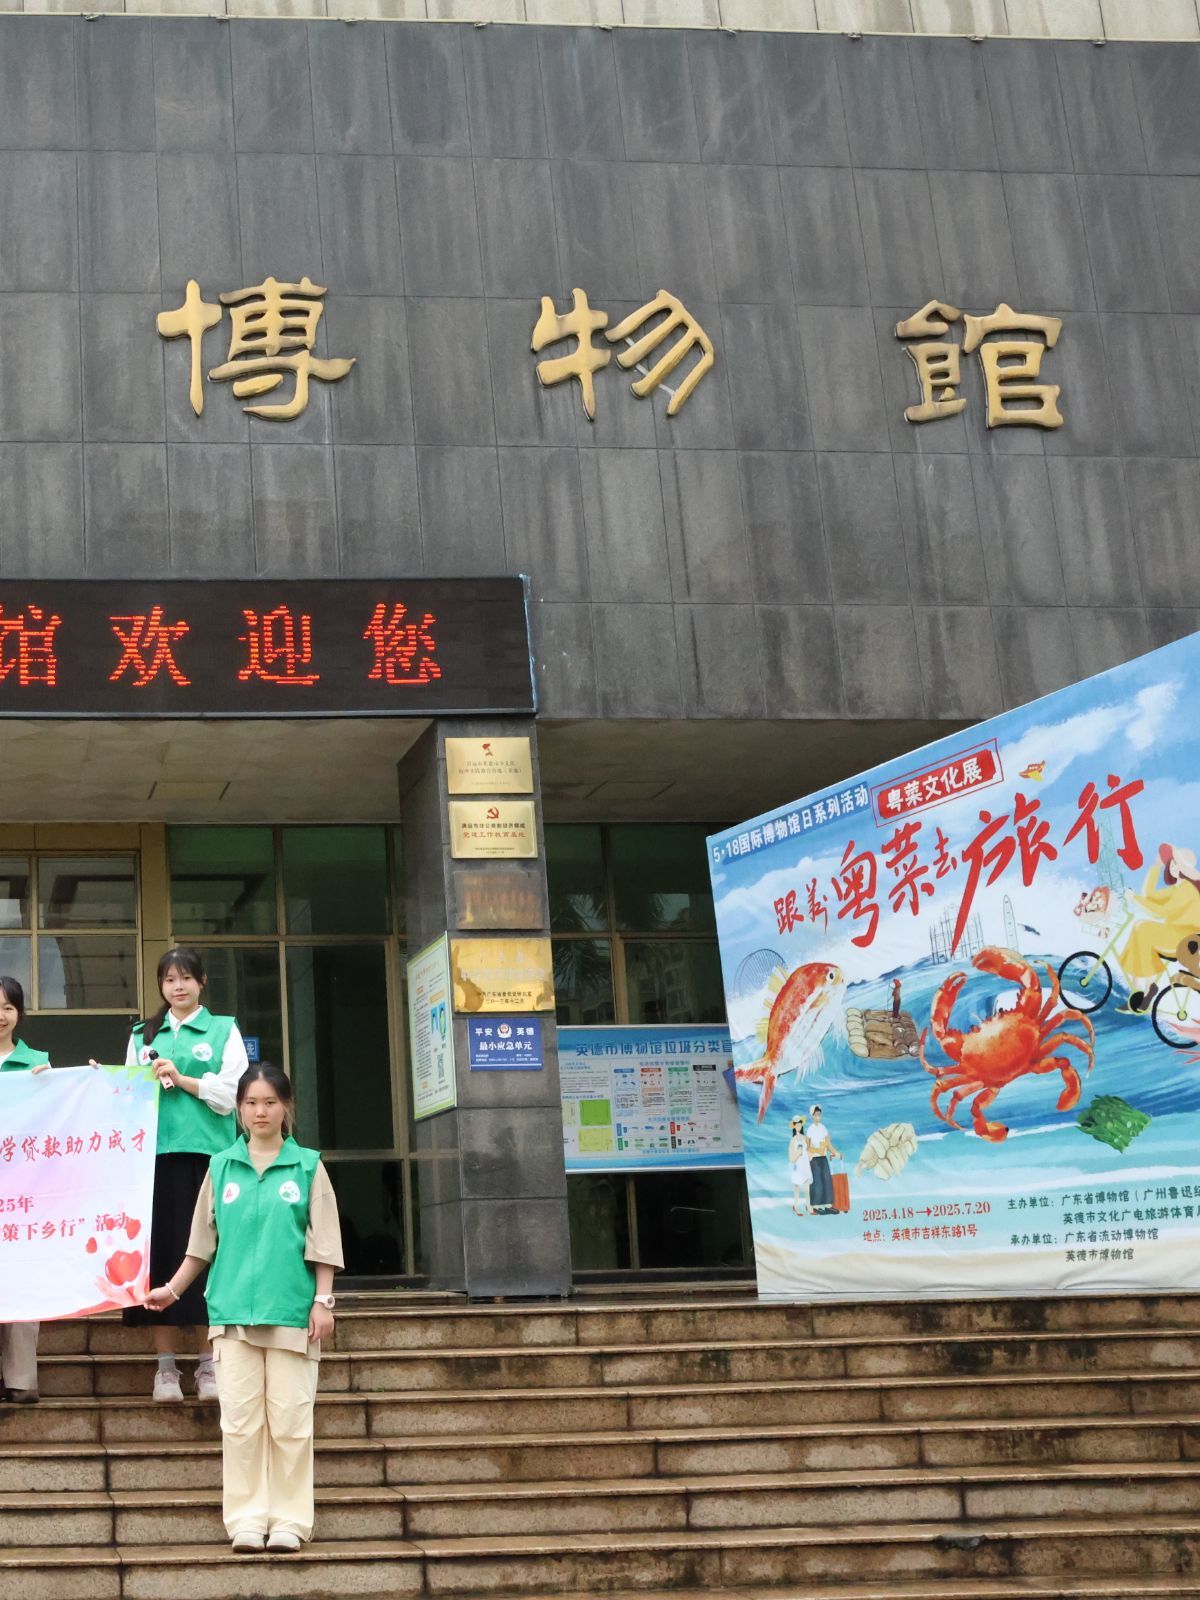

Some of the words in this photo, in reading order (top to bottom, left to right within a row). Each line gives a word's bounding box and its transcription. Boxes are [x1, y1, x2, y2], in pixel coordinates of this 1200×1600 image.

[885, 755, 983, 812] 粤菜文化展
[712, 784, 869, 864] 5·18国际博物馆日系列活动
[475, 1028, 493, 1037] 平安
[516, 1027, 535, 1036] 英德
[479, 1041, 533, 1051] 最小应急单元
[1063, 1204, 1200, 1226] 英德市文化广电旅游体育
[1065, 1248, 1135, 1263] 英德市博物馆
